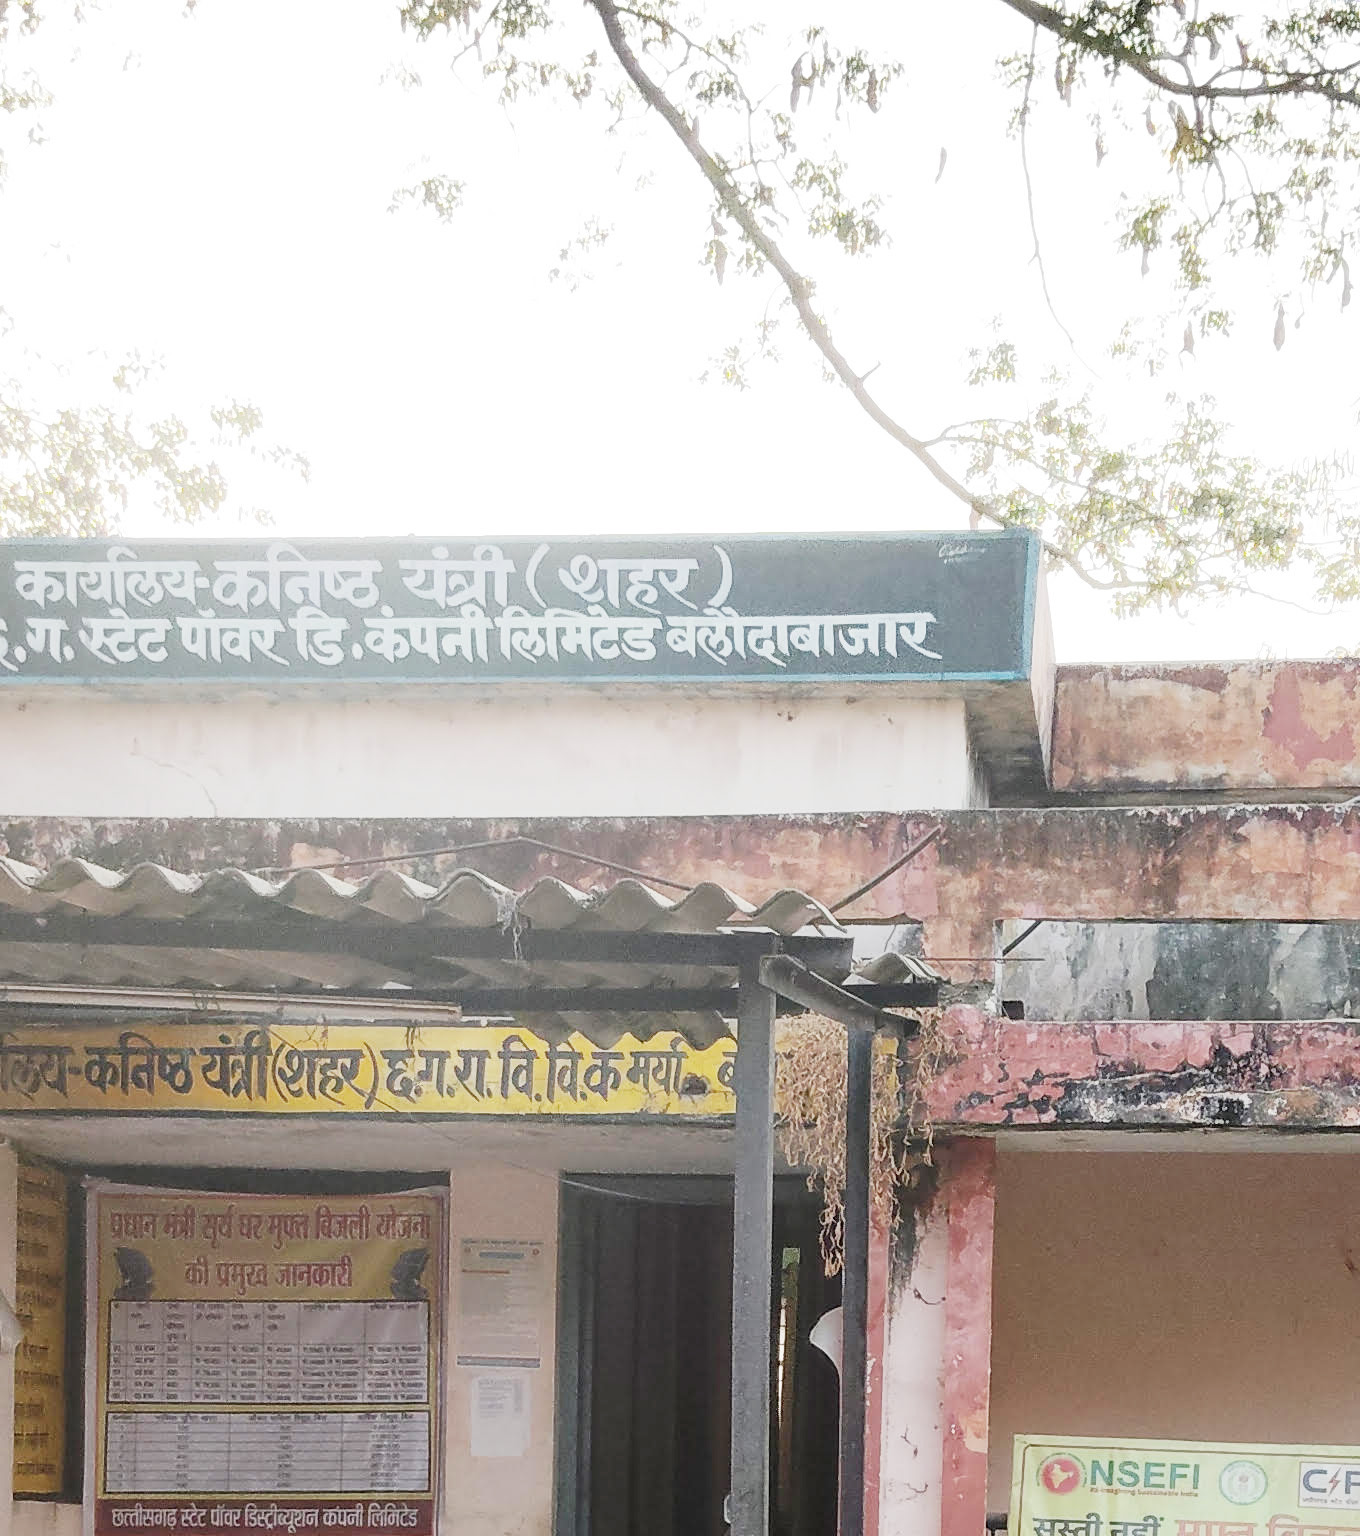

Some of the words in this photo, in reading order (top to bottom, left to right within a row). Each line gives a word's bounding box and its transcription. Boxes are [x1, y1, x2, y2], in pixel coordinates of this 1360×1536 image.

[398, 543, 516, 612] यंत्री
[77, 608, 172, 665] स्टेट
[175, 608, 290, 666] पॉवर
[494, 605, 663, 664] लिमिटेड
[198, 1028, 274, 1102] यंत्री
[163, 1204, 197, 1240] मंत्री
[239, 1213, 264, 1240] घर
[315, 1203, 371, 1241] बिजली
[375, 1203, 432, 1240] योजना
[184, 1256, 209, 1287] की
[216, 1262, 269, 1296] प्रमुख
[275, 1255, 353, 1288] जानकारी
[1090, 1460, 1200, 1490] NSEFI
[111, 1502, 178, 1531] छत्तीसगढ़
[181, 1502, 208, 1527] स्टेट
[210, 1503, 241, 1527] पॉवर
[322, 1502, 363, 1528] कंपनी
[366, 1502, 420, 1528] लिमिटेड
